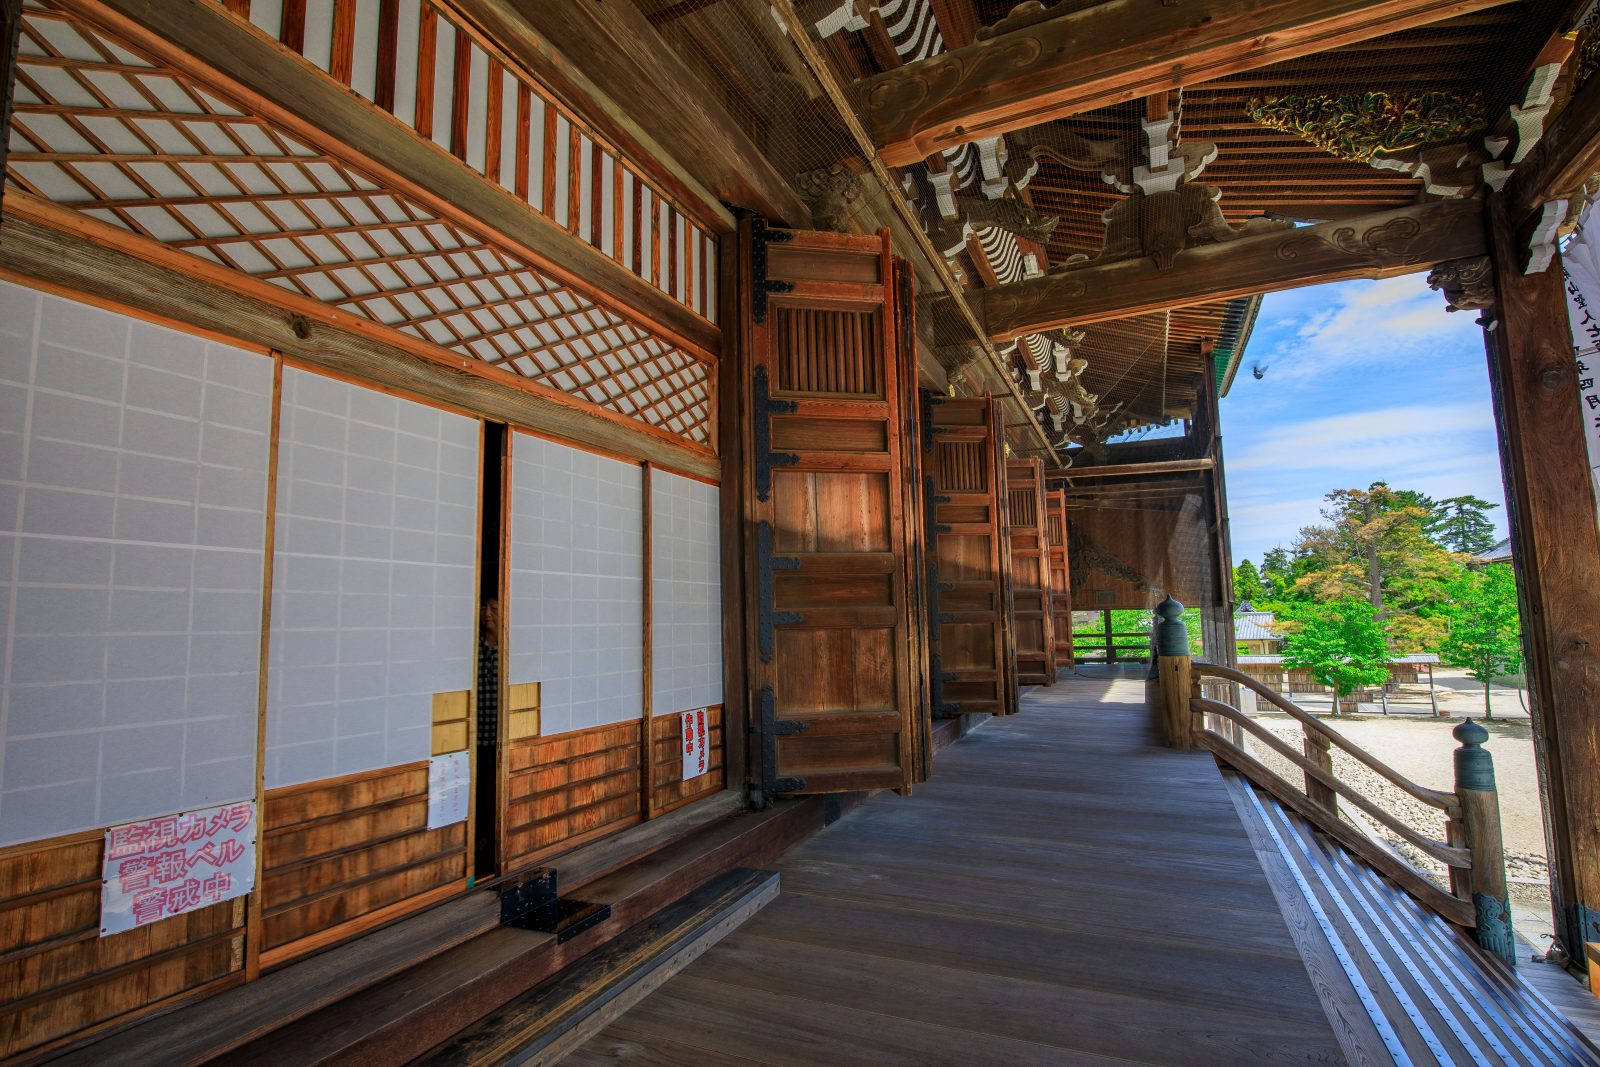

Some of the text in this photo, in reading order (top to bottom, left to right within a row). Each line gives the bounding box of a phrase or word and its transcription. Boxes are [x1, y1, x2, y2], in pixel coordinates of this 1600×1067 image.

[685, 713, 693, 756] 作動中
[108, 804, 254, 860] 監視カメラ
[119, 838, 246, 894] 警報ベル
[133, 871, 231, 925] 警戒中
